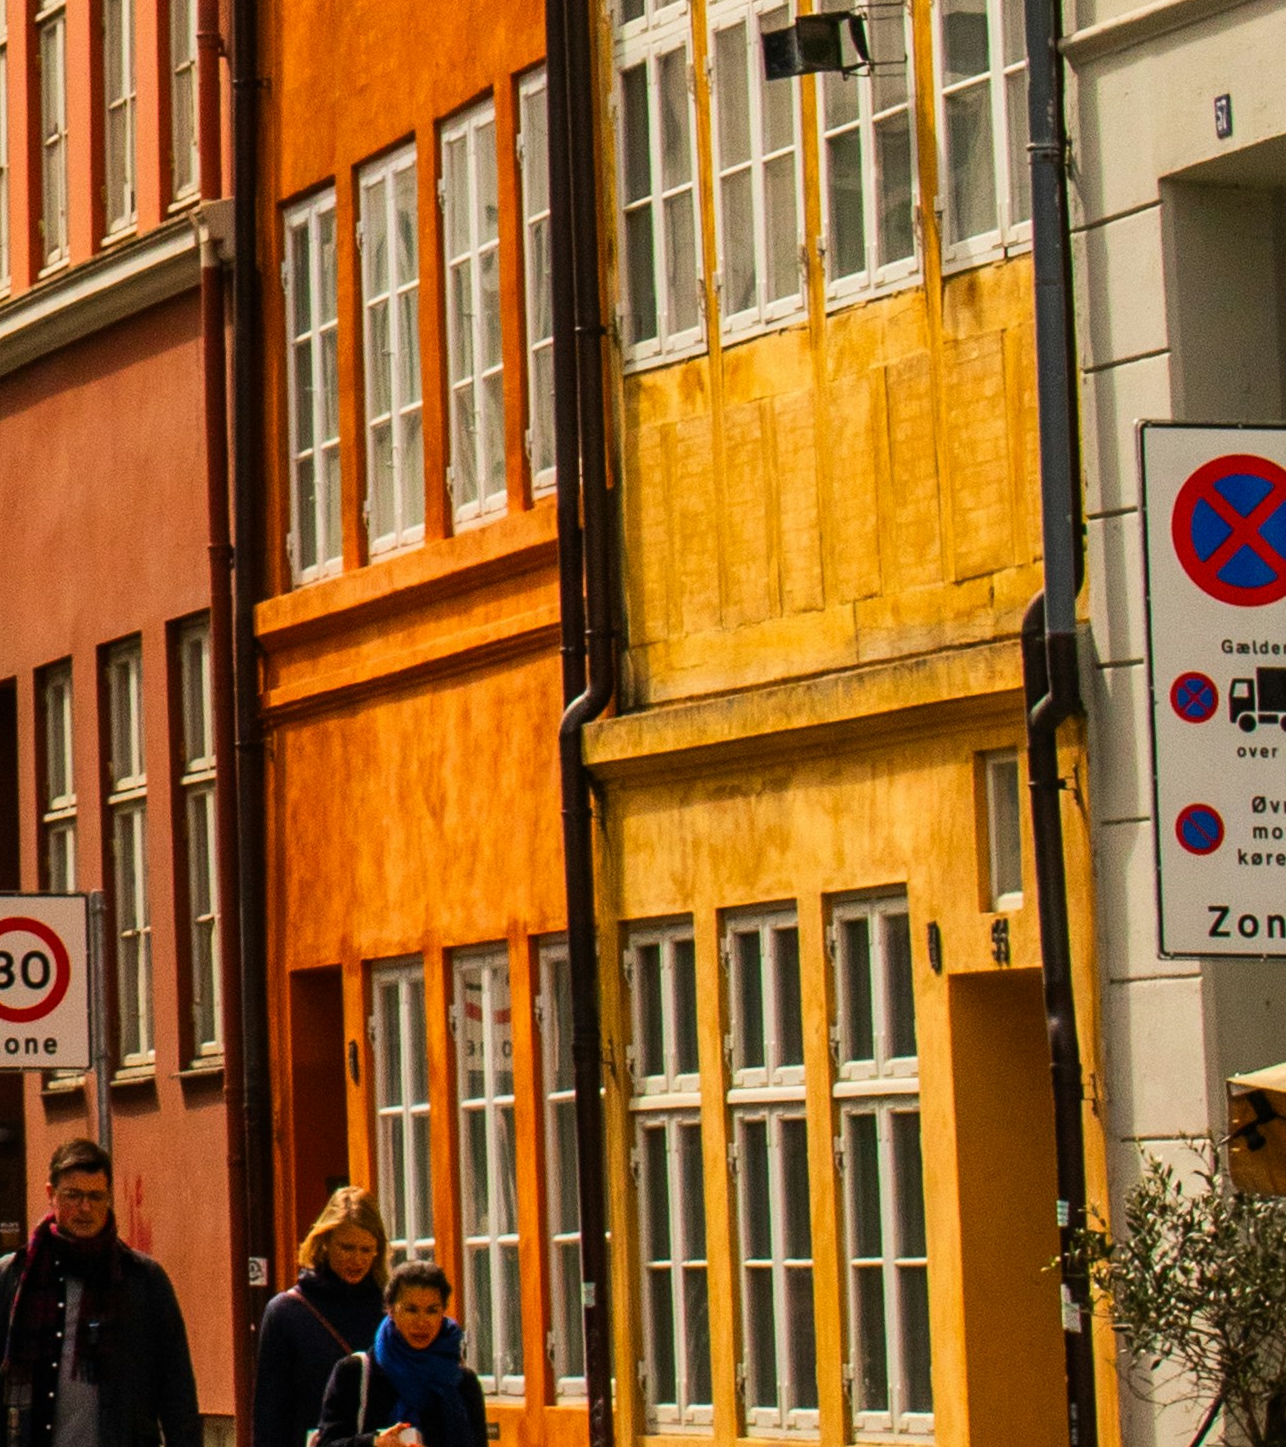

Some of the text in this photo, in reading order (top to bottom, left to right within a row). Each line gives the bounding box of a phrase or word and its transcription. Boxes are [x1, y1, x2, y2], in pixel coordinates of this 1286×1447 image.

[1221, 639, 1286, 655] Gælde
[1236, 746, 1278, 758] over
[1252, 795, 1286, 814] Øv
[1237, 848, 1286, 866] køre
[1207, 905, 1286, 939] Zon
